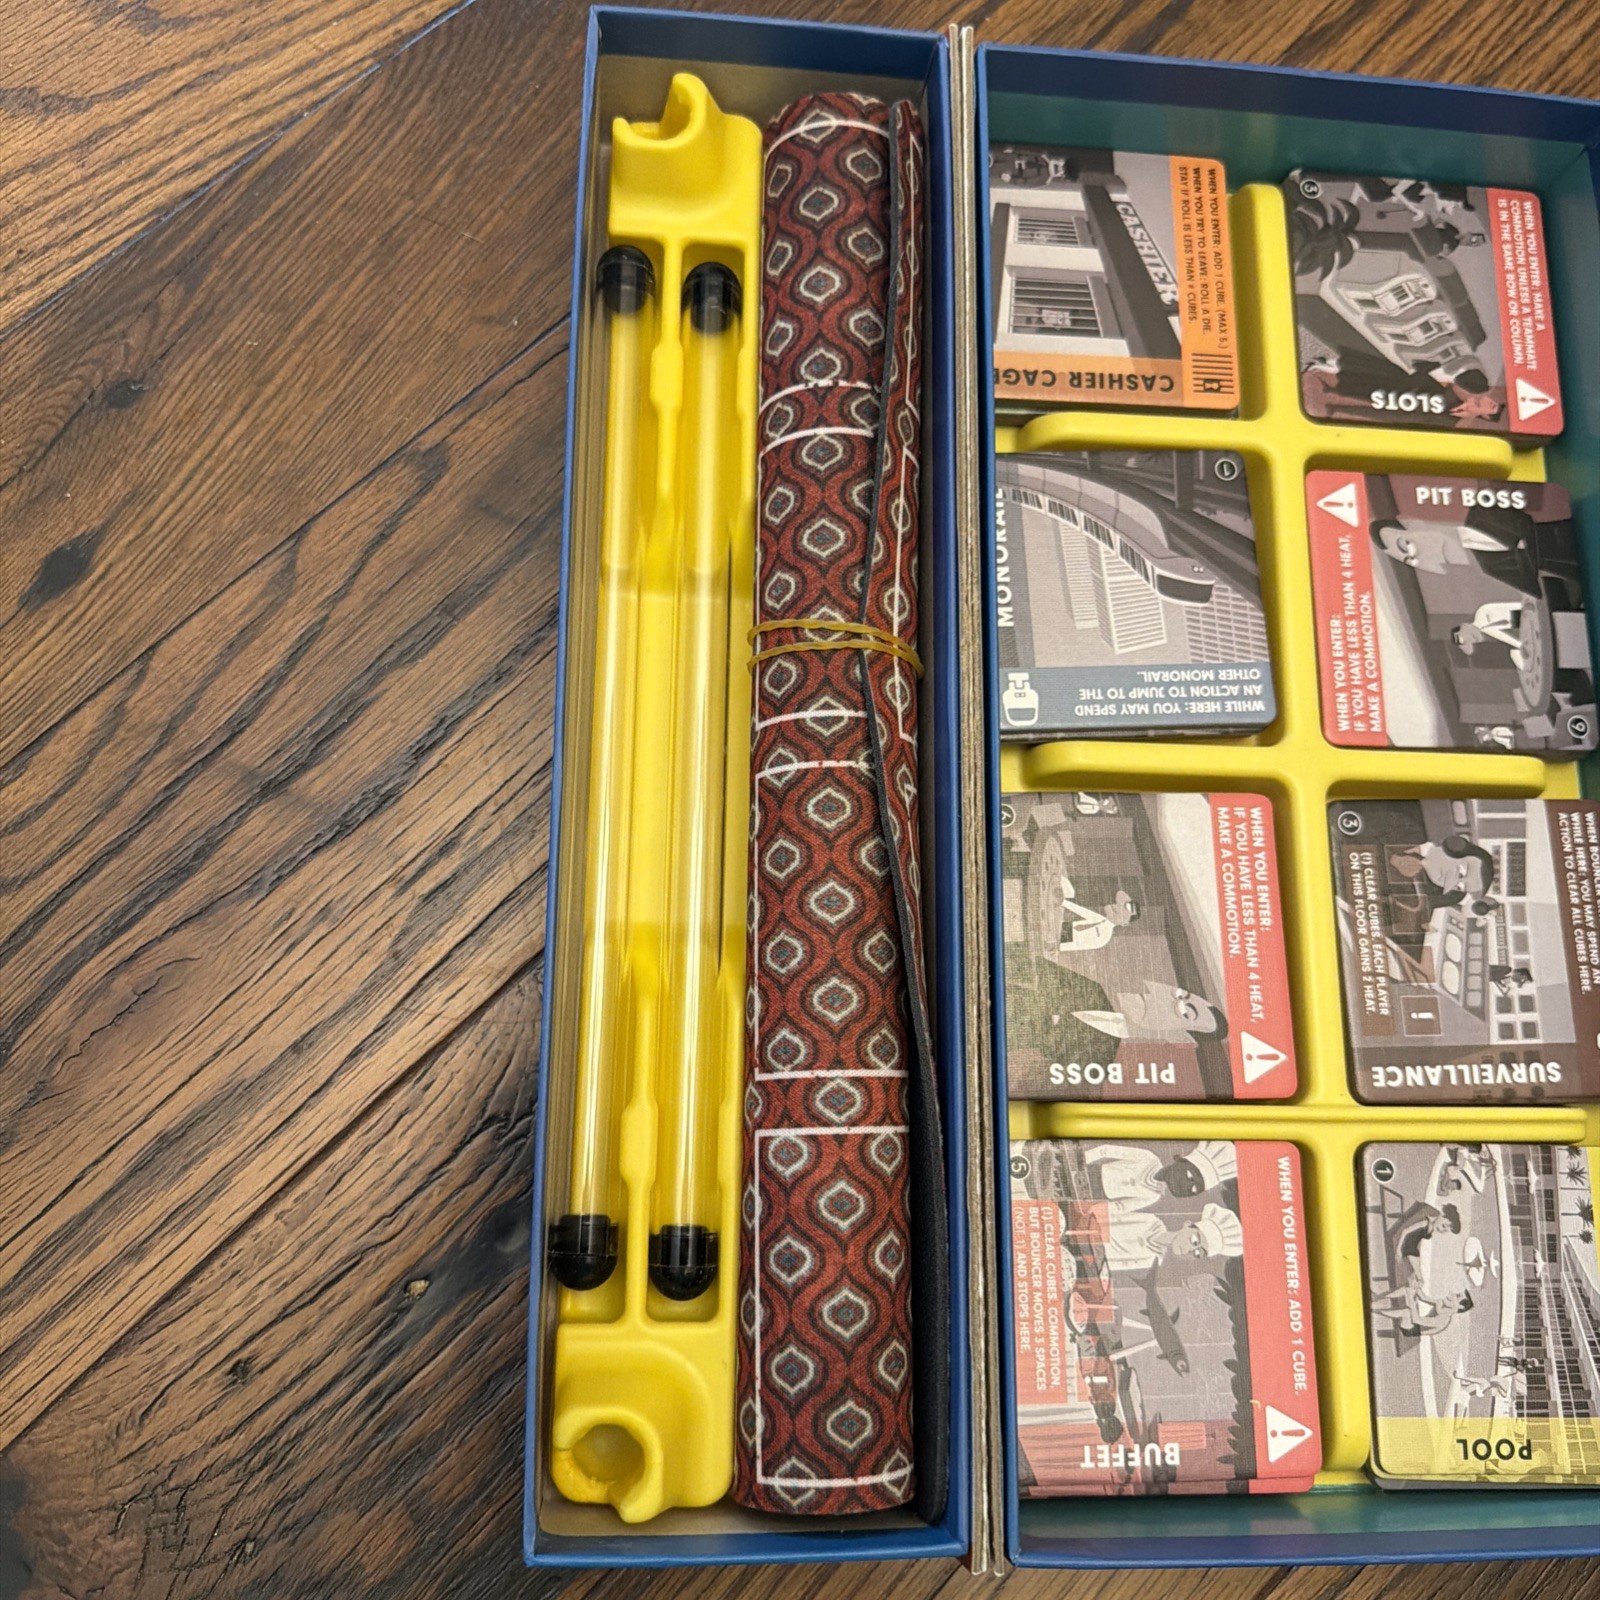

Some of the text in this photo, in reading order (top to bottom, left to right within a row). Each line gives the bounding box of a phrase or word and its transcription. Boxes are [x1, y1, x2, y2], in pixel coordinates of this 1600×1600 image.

[1179, 166, 1189, 186] STAY
[1193, 167, 1201, 193] WHEN
[1207, 168, 1217, 194] WHEN
[1181, 189, 1189, 197] IF
[1194, 196, 1204, 216] YOU
[1209, 197, 1219, 216] YOU
[1181, 200, 1191, 220] ROLL
[1523, 201, 1535, 230] WHEN
[1183, 223, 1192, 232] IS
[1196, 218, 1205, 234] TRY
[1116, 204, 1178, 305] CASHIER
[1183, 234, 1193, 254] LESS
[1197, 236, 1206, 249] TO
[1526, 232, 1538, 254] YOU
[1185, 257, 1195, 281] THAN
[1213, 251, 1223, 270] ADD
[1200, 283, 1210, 305] ROLL
[1497, 198, 1525, 367] IS IN THE SAME ROW OR COLUMN.
[1510, 200, 1538, 371] COMMOTION UNLESS A TEAMMATE
[1532, 291, 1545, 321] MAKE
[1215, 309, 1227, 334] (MAX
[1535, 322, 1546, 331] A
[1069, 371, 1174, 392] CASHIER
[1370, 390, 1445, 414] SLOTS
[1415, 485, 1526, 509] PIT BOSS
[1341, 571, 1354, 579] 4
[1342, 582, 1356, 617] THAN
[1345, 620, 1359, 648] LESS
[1137, 668, 1260, 682] OTHER MONORAIL.
[1330, 614, 1350, 732] WHEN YOU ENTER:
[1348, 652, 1362, 685] HAVE
[1359, 591, 1382, 732] MAKE A COMMOTION.
[1078, 684, 1263, 700] AN ACTION TO JUMP TO THE
[1351, 689, 1365, 717] YOU
[1074, 700, 1266, 716] WHILE HERE: YOU MAY SPEND
[1354, 720, 1366, 732] IF
[1584, 812, 1598, 843] WHEN
[1250, 807, 1272, 932] WHEN YOU ENTER:
[1349, 852, 1360, 870] ON
[1217, 807, 1241, 958] MAKE A COMMOTION.
[1351, 872, 1363, 896] THIS
[1364, 868, 1377, 900] CLEAR
[1558, 812, 1591, 995] ACTION TO CLEAR ALL CUBES HERE.
[1570, 812, 1600, 985] WHILE HERE: YOU MAY SPEND AN
[1233, 807, 1264, 1023] IF YOU HAVE LESS THAN 4 HEAT,
[1354, 899, 1368, 935] FLOOR
[1368, 903, 1381, 941] CUBES.
[1358, 938, 1372, 973] GAINS
[1372, 943, 1384, 973] EACH
[1363, 985, 1376, 1015] HEAT.
[1375, 976, 1390, 1016] PLAYER
[1049, 1062, 1176, 1085] PIT BOSS
[1371, 1062, 1562, 1087] SURVEILLANCE
[1278, 1156, 1292, 1201] WHEN
[1013, 1207, 1026, 1235] (NOT
[1029, 1207, 1039, 1229] BUT
[1281, 1205, 1296, 1239] YOU
[1044, 1223, 1055, 1259] CLEAR
[1017, 1251, 1027, 1277] AND
[1030, 1232, 1043, 1288] BOUNCER
[1284, 1243, 1299, 1296] ENTER:
[1046, 1263, 1057, 1303] CUBES.
[1018, 1281, 1029, 1318] STOPS
[1033, 1291, 1044, 1333] MOVES
[1288, 1298, 1302, 1332] ADD
[1035, 1347, 1047, 1391] SPACES
[1080, 1442, 1180, 1468] BUFFET
[1456, 1438, 1532, 1461] POOL
